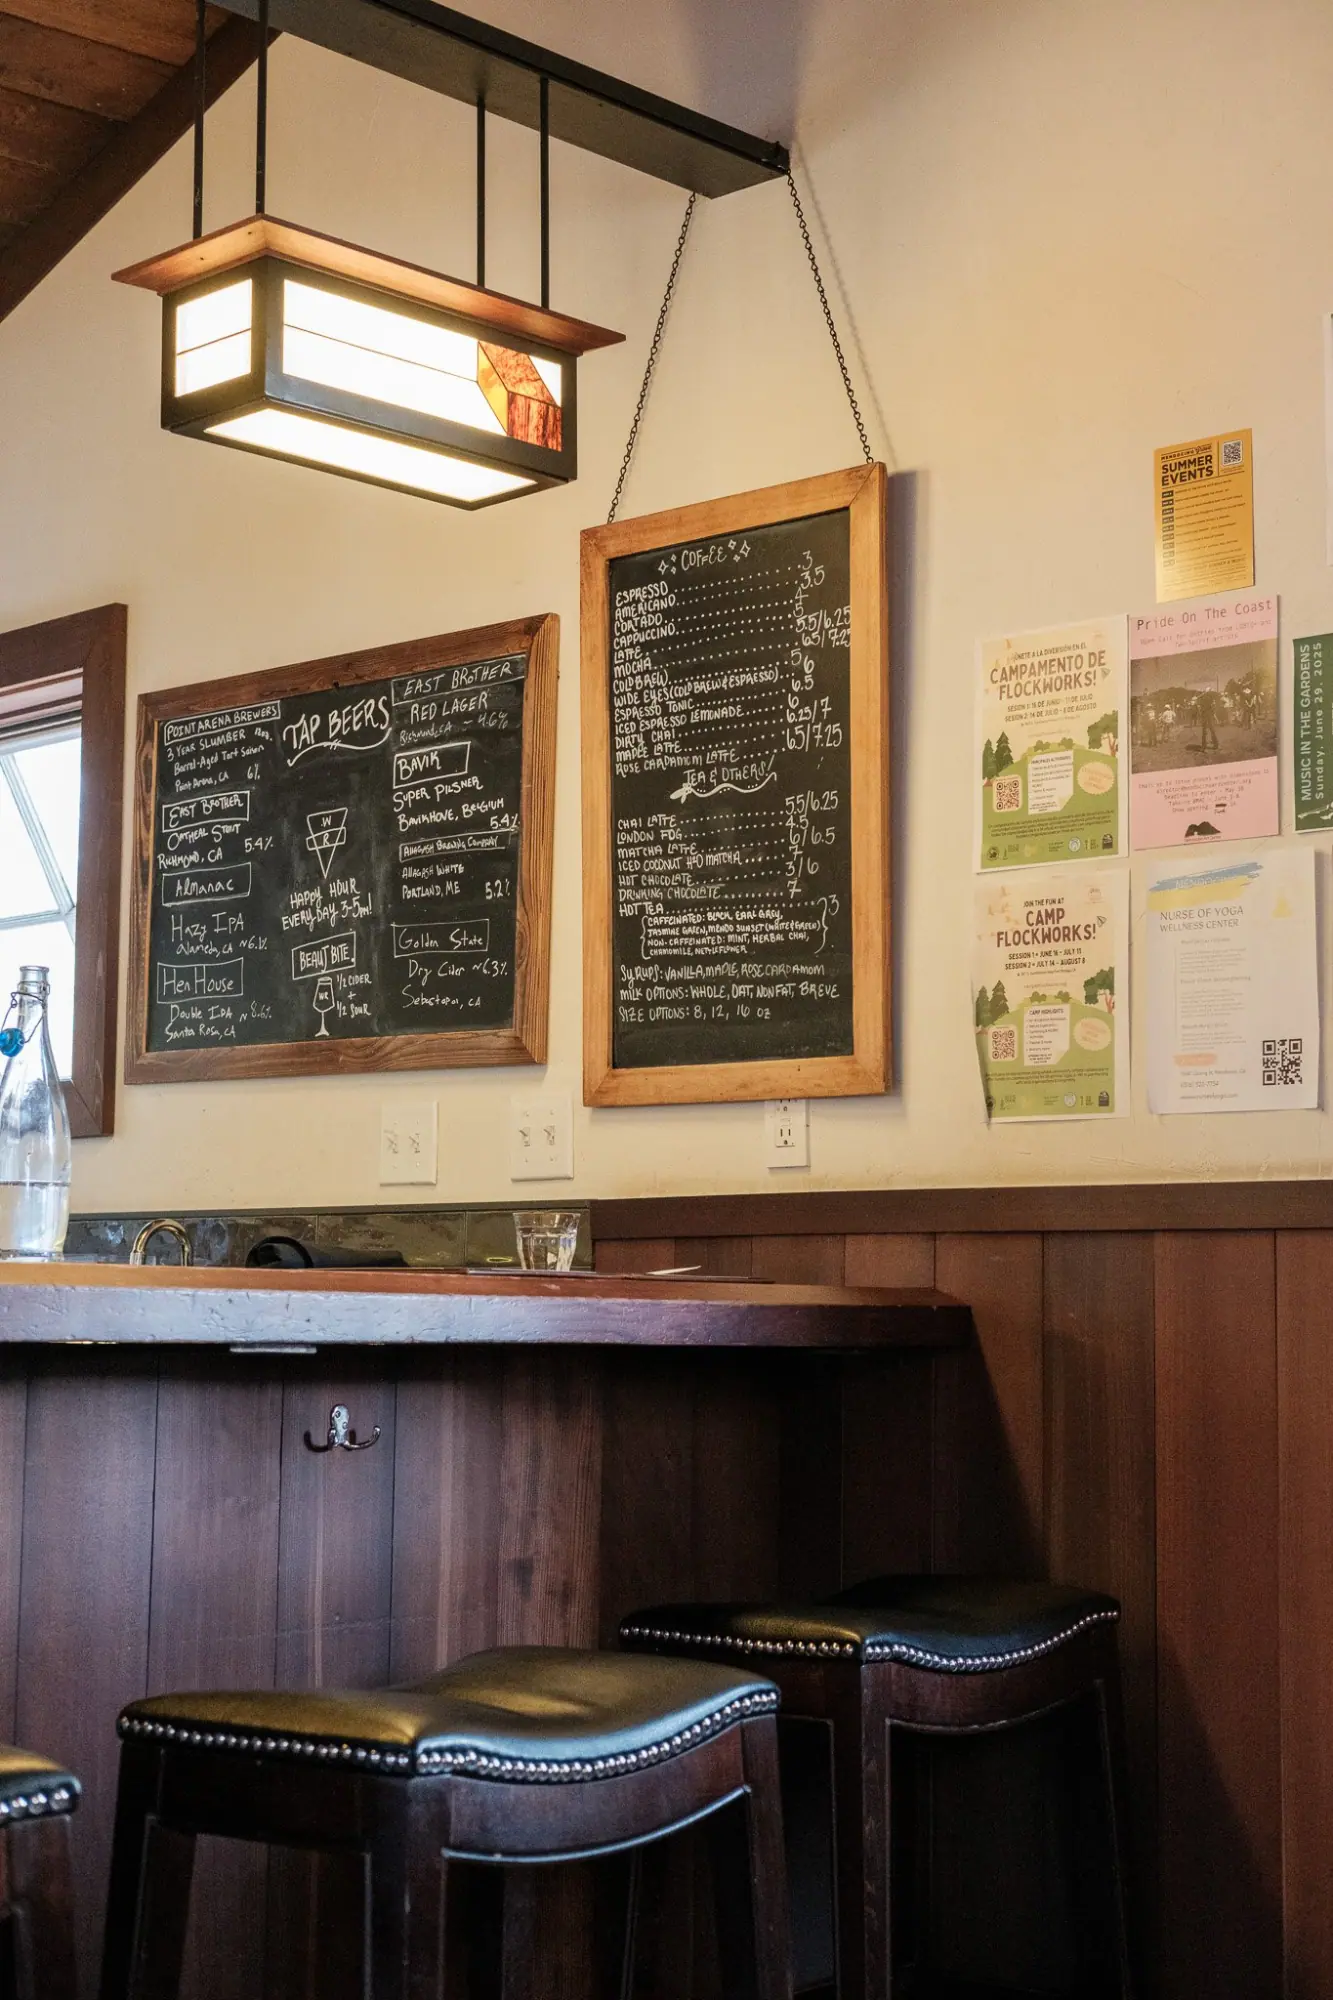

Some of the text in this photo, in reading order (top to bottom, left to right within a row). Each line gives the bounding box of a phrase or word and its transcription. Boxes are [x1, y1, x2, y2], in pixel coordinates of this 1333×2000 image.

[1161, 465, 1214, 487] EVENTS
[1162, 454, 1213, 474] SUMMER
[681, 545, 727, 571] COFFEE
[615, 550, 813, 607] ESPRESSO 3
[615, 565, 825, 622] AMERICANO 3.5
[614, 587, 809, 636] CORTADO 4
[1136, 600, 1272, 631] Pride On The Coast
[613, 603, 804, 650] CAPPUCCINO 5
[613, 646, 643, 665] LATTE
[790, 648, 801, 666] 5
[990, 654, 1084, 684] CAMPAMENTO
[1088, 650, 1106, 669] DE
[1313, 642, 1322, 676] 2025
[403, 661, 513, 698] EAST BROTHER
[613, 657, 652, 679] MOCHA
[614, 655, 815, 708] WIDE 6
[999, 670, 1097, 701] FLOCKWORKS!
[410, 691, 488, 725] RED LAGER
[614, 674, 814, 723] ESPRESSO TONIC 6.5
[167, 705, 277, 741] POINT ARENA BREWERS
[283, 695, 390, 749] TAP BEERS
[615, 693, 799, 735] ICED ESPRESSO LEMONADE 6
[1300, 643, 1312, 801] MUSIC IN THE GARDENS
[1315, 709, 1324, 740] June
[166, 729, 246, 762] 3 YEAR SLUMBER
[615, 728, 675, 752] DIRTY CHAI
[616, 740, 681, 762] MAPLE LATTE
[221, 744, 265, 761] Tart Saison
[615, 748, 740, 778] ROSE CARDAMOM LATTE
[397, 750, 442, 781] BAVIK
[683, 769, 706, 786] TEA
[392, 775, 484, 813] SUPER PILSNER
[168, 794, 244, 829] EAST BROTHER
[461, 797, 505, 819] BELGIUM
[618, 790, 839, 830] CHAI LATTE 5.5/6.25
[489, 813, 521, 830] 5.4%
[617, 815, 809, 845] LONDON FOG 4.5
[167, 823, 242, 851] OATMEAL STOUT
[244, 836, 274, 853] 5.4%
[207, 847, 223, 863] CA
[617, 842, 698, 859] MATCHA LATTE
[618, 844, 803, 872] ICED COCONUT MATCHA 7
[436, 863, 465, 876] WHITE
[618, 857, 819, 887] HOT CHOCOLATE 3/6
[175, 877, 235, 897] Almanac
[290, 877, 360, 909] HAPPY HOUR
[445, 878, 511, 900] ME 5.2%
[618, 879, 802, 902] DRINKING CHOCOLATE 7
[618, 893, 840, 917] HOT TEA 3
[1023, 897, 1064, 908] JOIN THE FUN AT
[1160, 905, 1244, 921] NURSE OF YOGA
[171, 911, 245, 943] Hazy IPA
[647, 910, 757, 927] CAFFEINATED: EARL
[1026, 907, 1066, 927] CAMP
[1160, 918, 1240, 932] WELLNESS CENTER
[398, 928, 484, 950] Golden State
[647, 923, 764, 938] JASMINE SUNSET
[752, 932, 785, 943] HERBAL
[996, 923, 1096, 948] FLOCKWORKS!
[1005, 957, 1081, 970] SESSION JULY AUGUST
[1008, 948, 1075, 960] SESSION JUNE JULY
[347, 973, 372, 986] CIDER
[408, 959, 466, 987] Dry Cider
[620, 962, 825, 989] SYRUPS: ROSE CARDAMOM
[619, 981, 840, 1001] MILK OPTIONS: WHOLE, OAT, BREVE
[170, 1003, 233, 1023] Double IPA
[350, 1003, 372, 1018] SOUR
[618, 1004, 750, 1023] SIZE OPTIONS: 16
[165, 1022, 196, 1043] Santa
